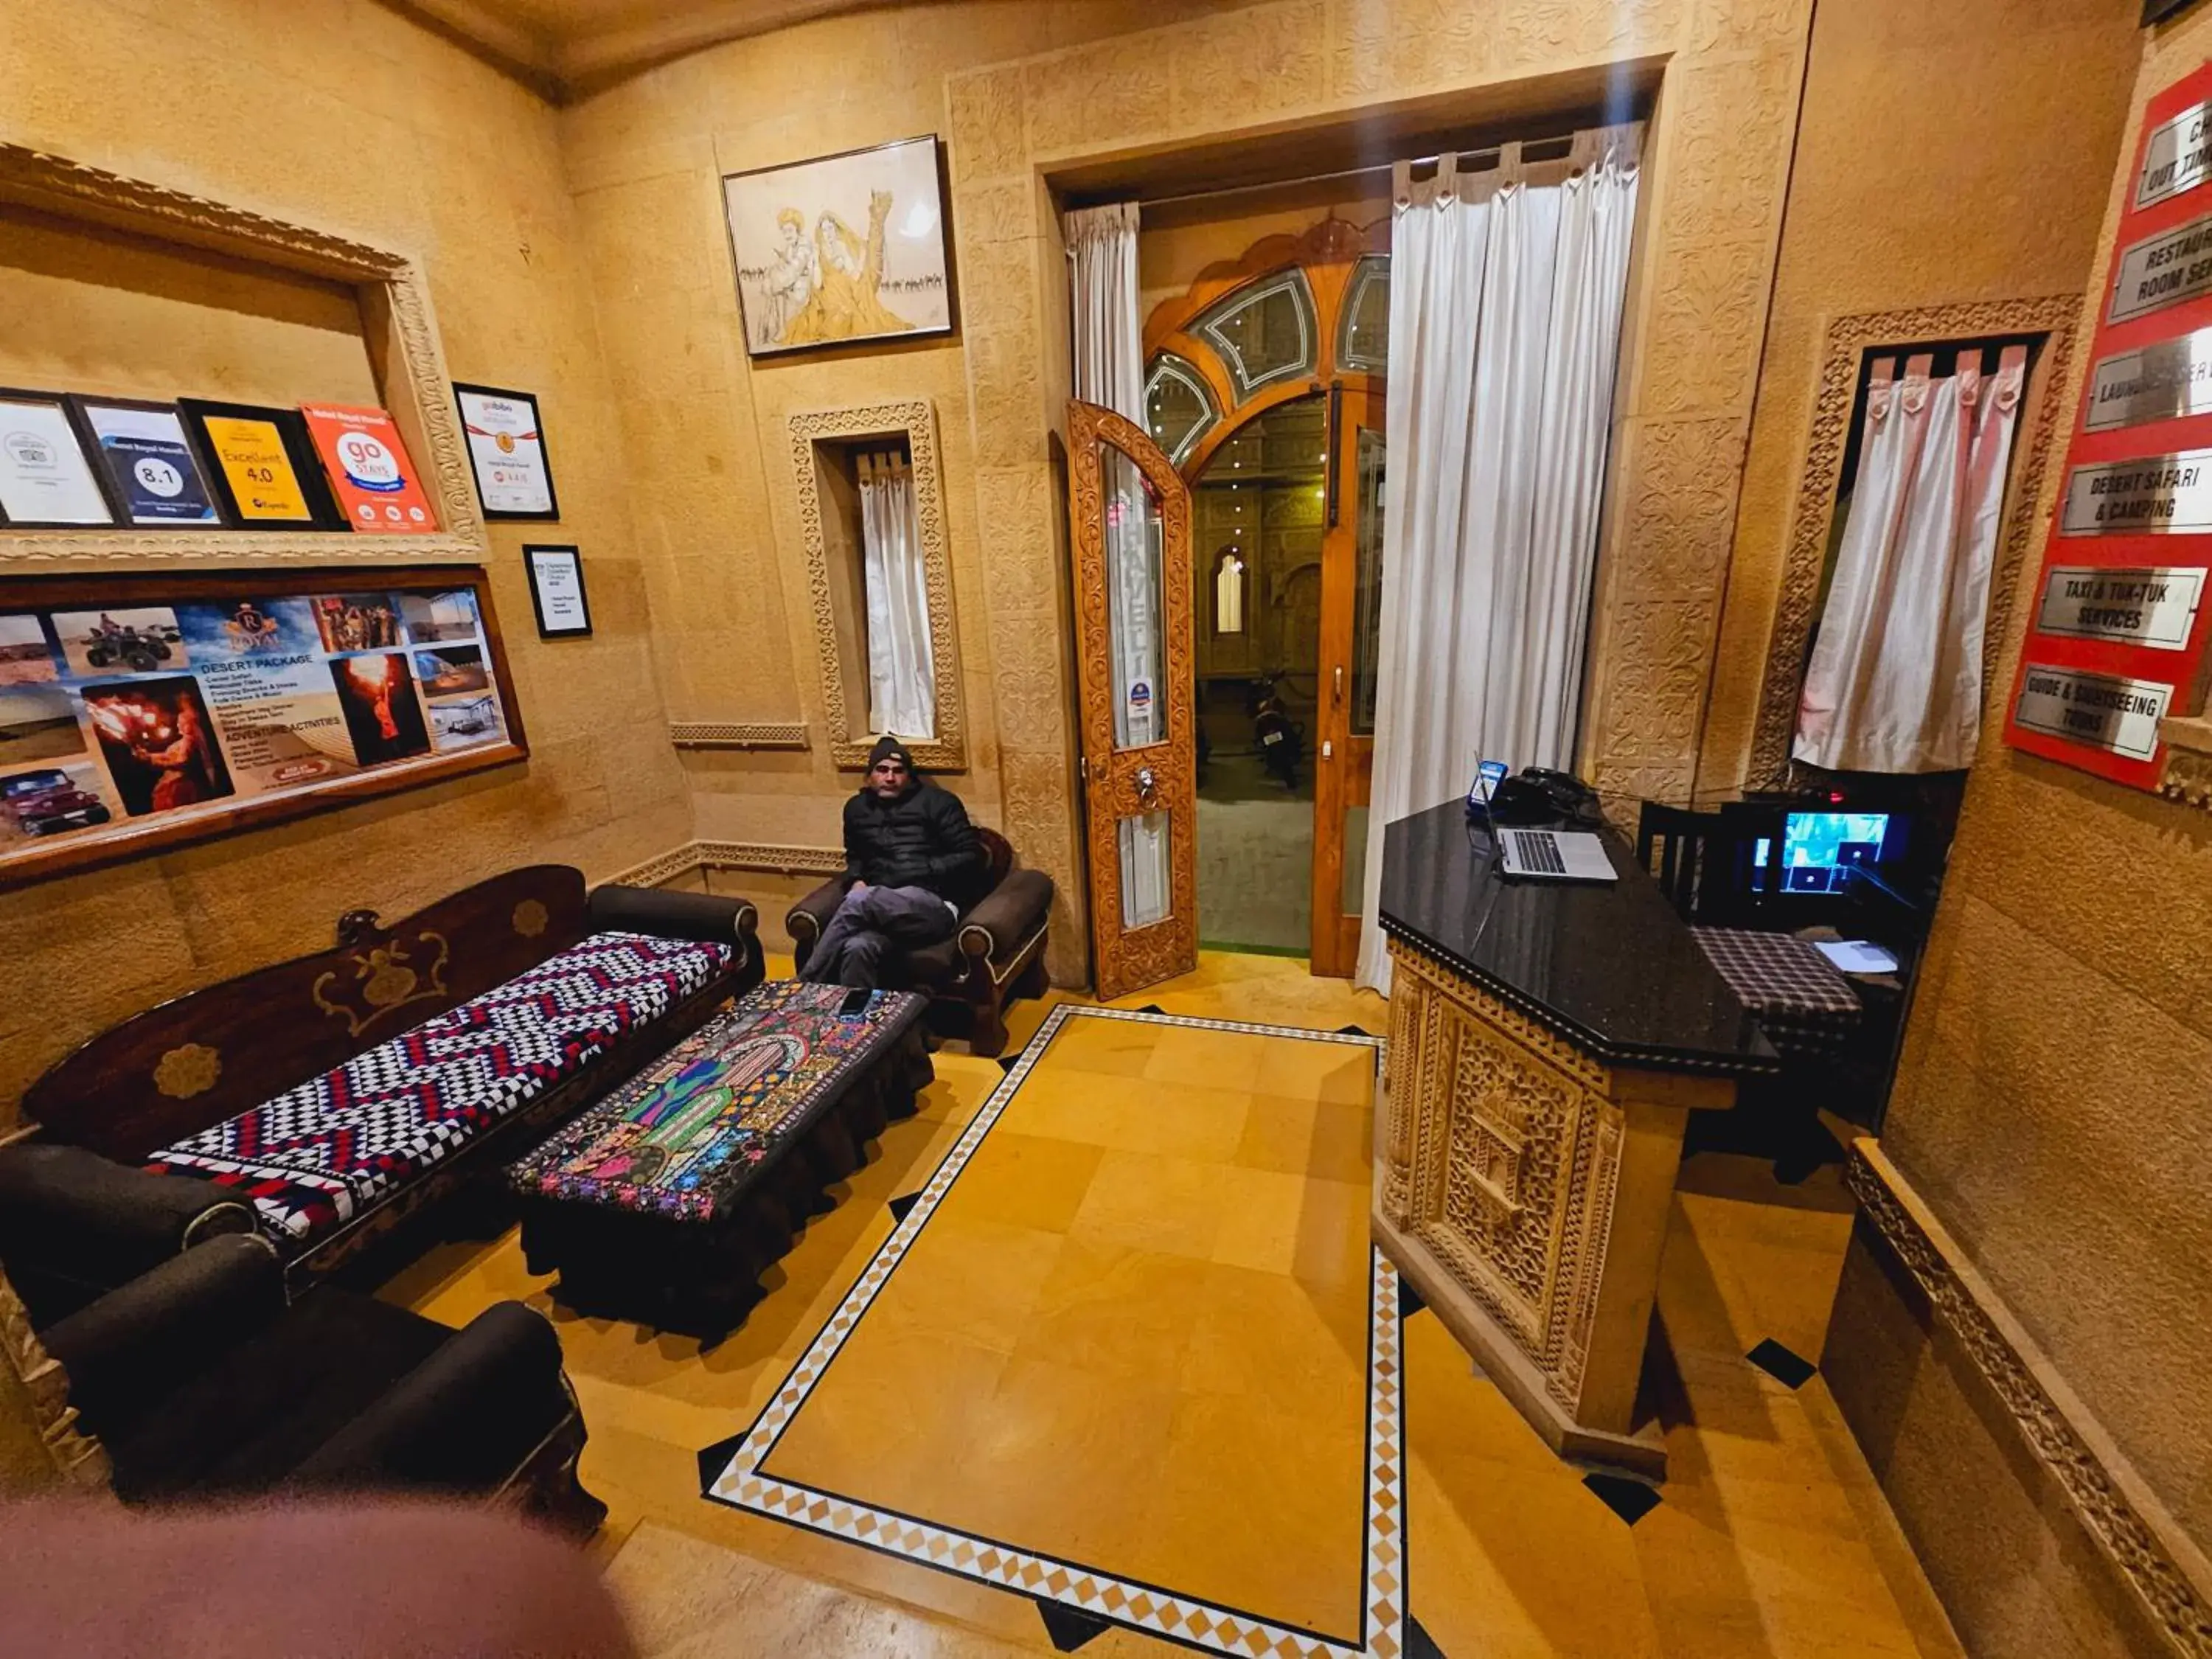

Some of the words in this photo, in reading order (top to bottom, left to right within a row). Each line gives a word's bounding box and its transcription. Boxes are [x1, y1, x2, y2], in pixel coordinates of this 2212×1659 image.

[2149, 160, 2178, 191] OUT
[2137, 267, 2184, 302] ROOM
[221, 448, 283, 465] Excellent
[348, 442, 381, 463] go
[142, 467, 174, 484] 8.1
[247, 467, 274, 484] 4.0
[355, 464, 389, 476] STAYS
[2091, 472, 2141, 495] DESERT
[2144, 467, 2200, 490] SAFARI
[2096, 503, 2104, 521] &
[2109, 498, 2176, 521] CAMPING
[2065, 580, 2093, 599] TAXI
[2110, 582, 2169, 602] TUK-TUK
[2077, 606, 2143, 629] SERVICES
[201, 660, 252, 675] DESERT
[254, 654, 313, 668] PACKAGE
[2062, 682, 2070, 700] &
[226, 723, 290, 742] ADVENTURE
[289, 717, 341, 732] ACTIVITIES
